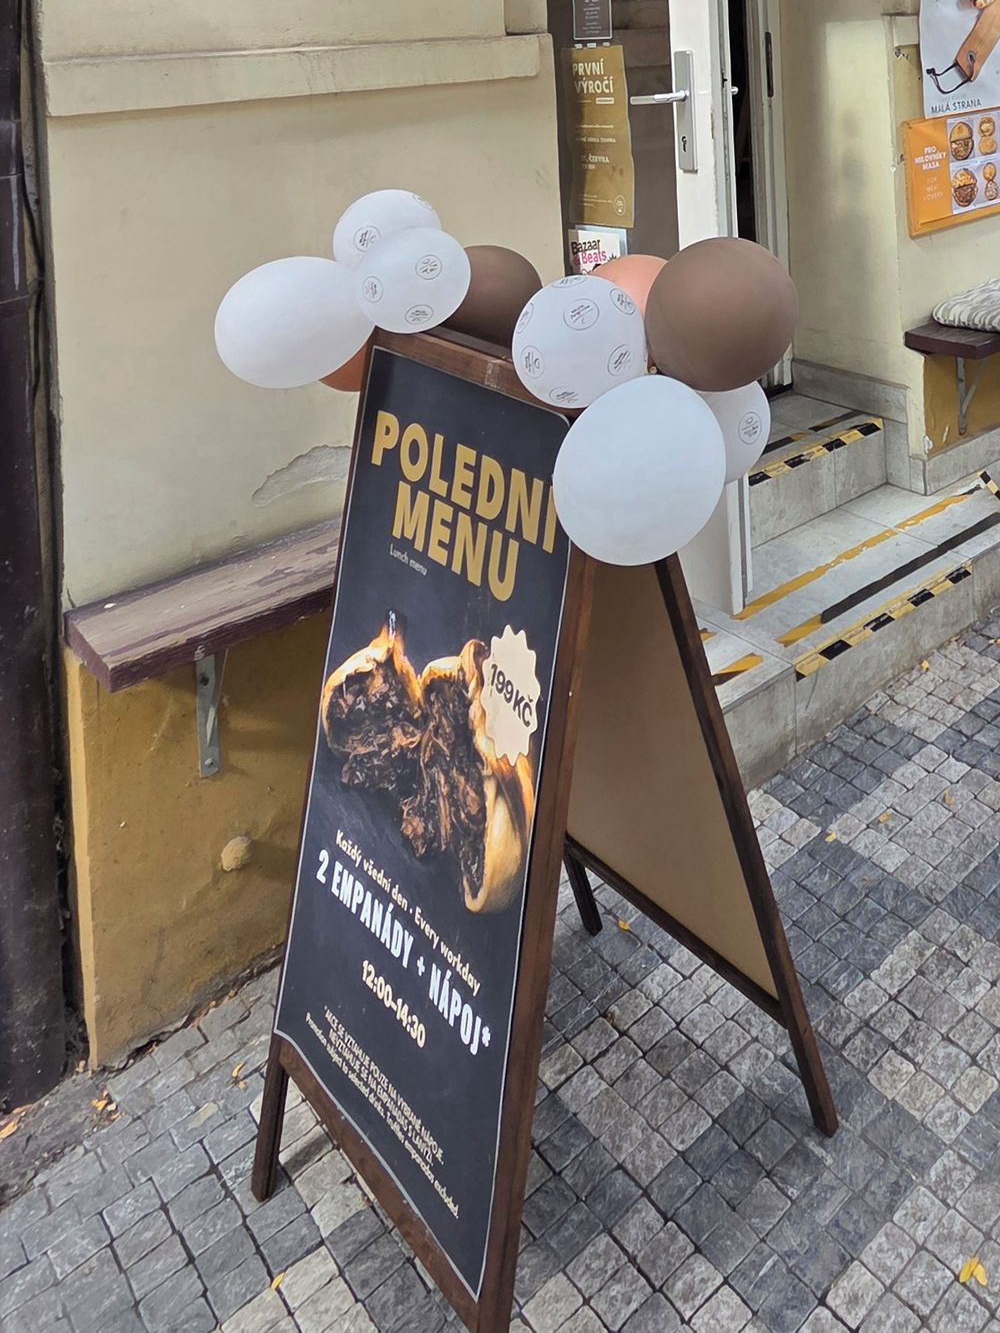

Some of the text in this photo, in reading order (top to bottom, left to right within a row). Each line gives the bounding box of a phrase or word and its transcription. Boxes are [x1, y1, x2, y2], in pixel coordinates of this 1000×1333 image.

[573, 58, 604, 76] PRVNÍ
[575, 76, 614, 93] VÝROČÍ
[931, 99, 982, 115] MALÁ STRANA
[571, 239, 600, 255] Bazaar
[581, 251, 607, 264] Beats
[391, 480, 520, 602] MENU
[389, 543, 428, 577] Lunch menu
[316, 849, 329, 884] 2
[331, 861, 414, 969] EMPANÁDY
[417, 956, 425, 977] +
[336, 829, 481, 997] Každý všední den Every workday
[369, 1061, 388, 1090] POUZE
